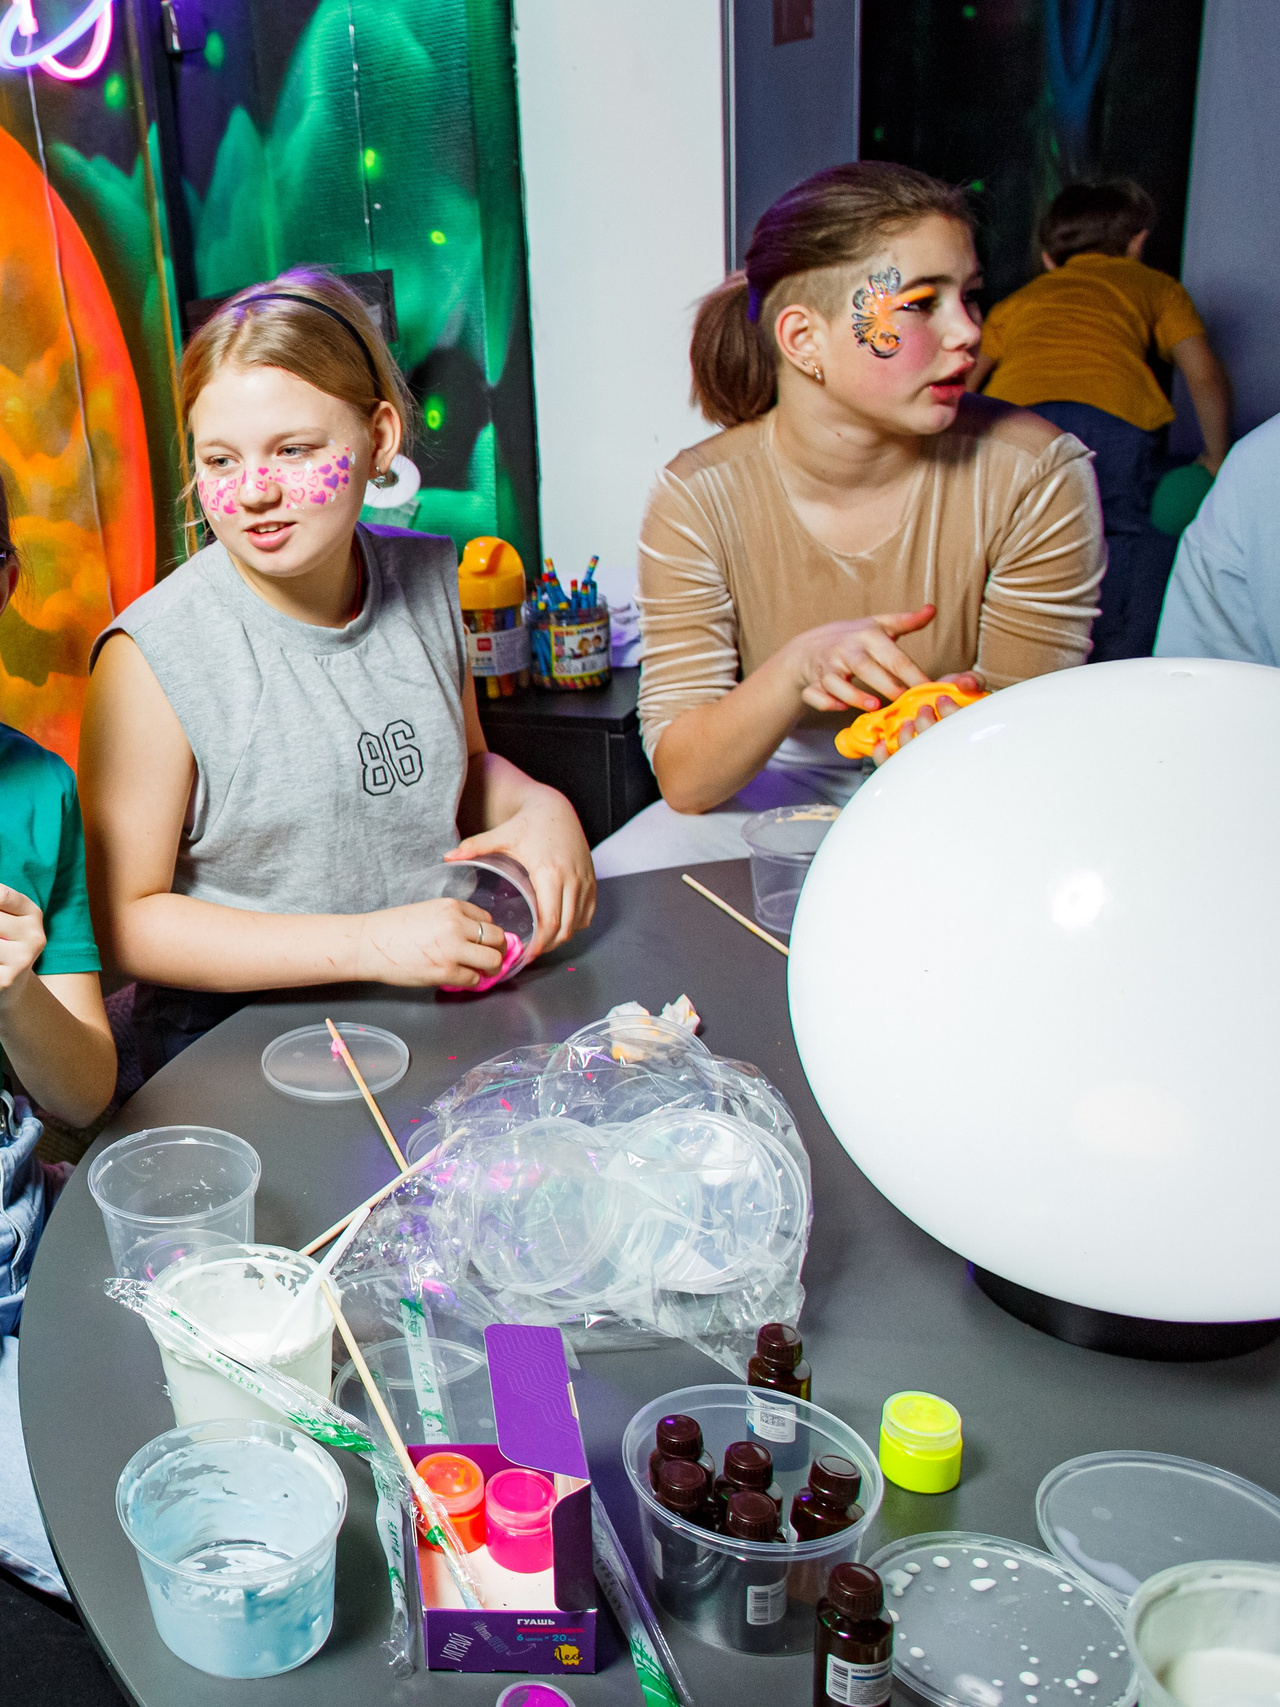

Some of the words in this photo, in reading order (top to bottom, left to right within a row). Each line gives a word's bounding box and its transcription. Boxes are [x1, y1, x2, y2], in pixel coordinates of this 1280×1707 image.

[357, 719, 424, 796] 86
[516, 1618, 556, 1626] ГУАШЬ
[440, 1632, 474, 1662] ИГРАЙ
[516, 1633, 524, 1641] 6
[552, 1633, 567, 1642] 20
